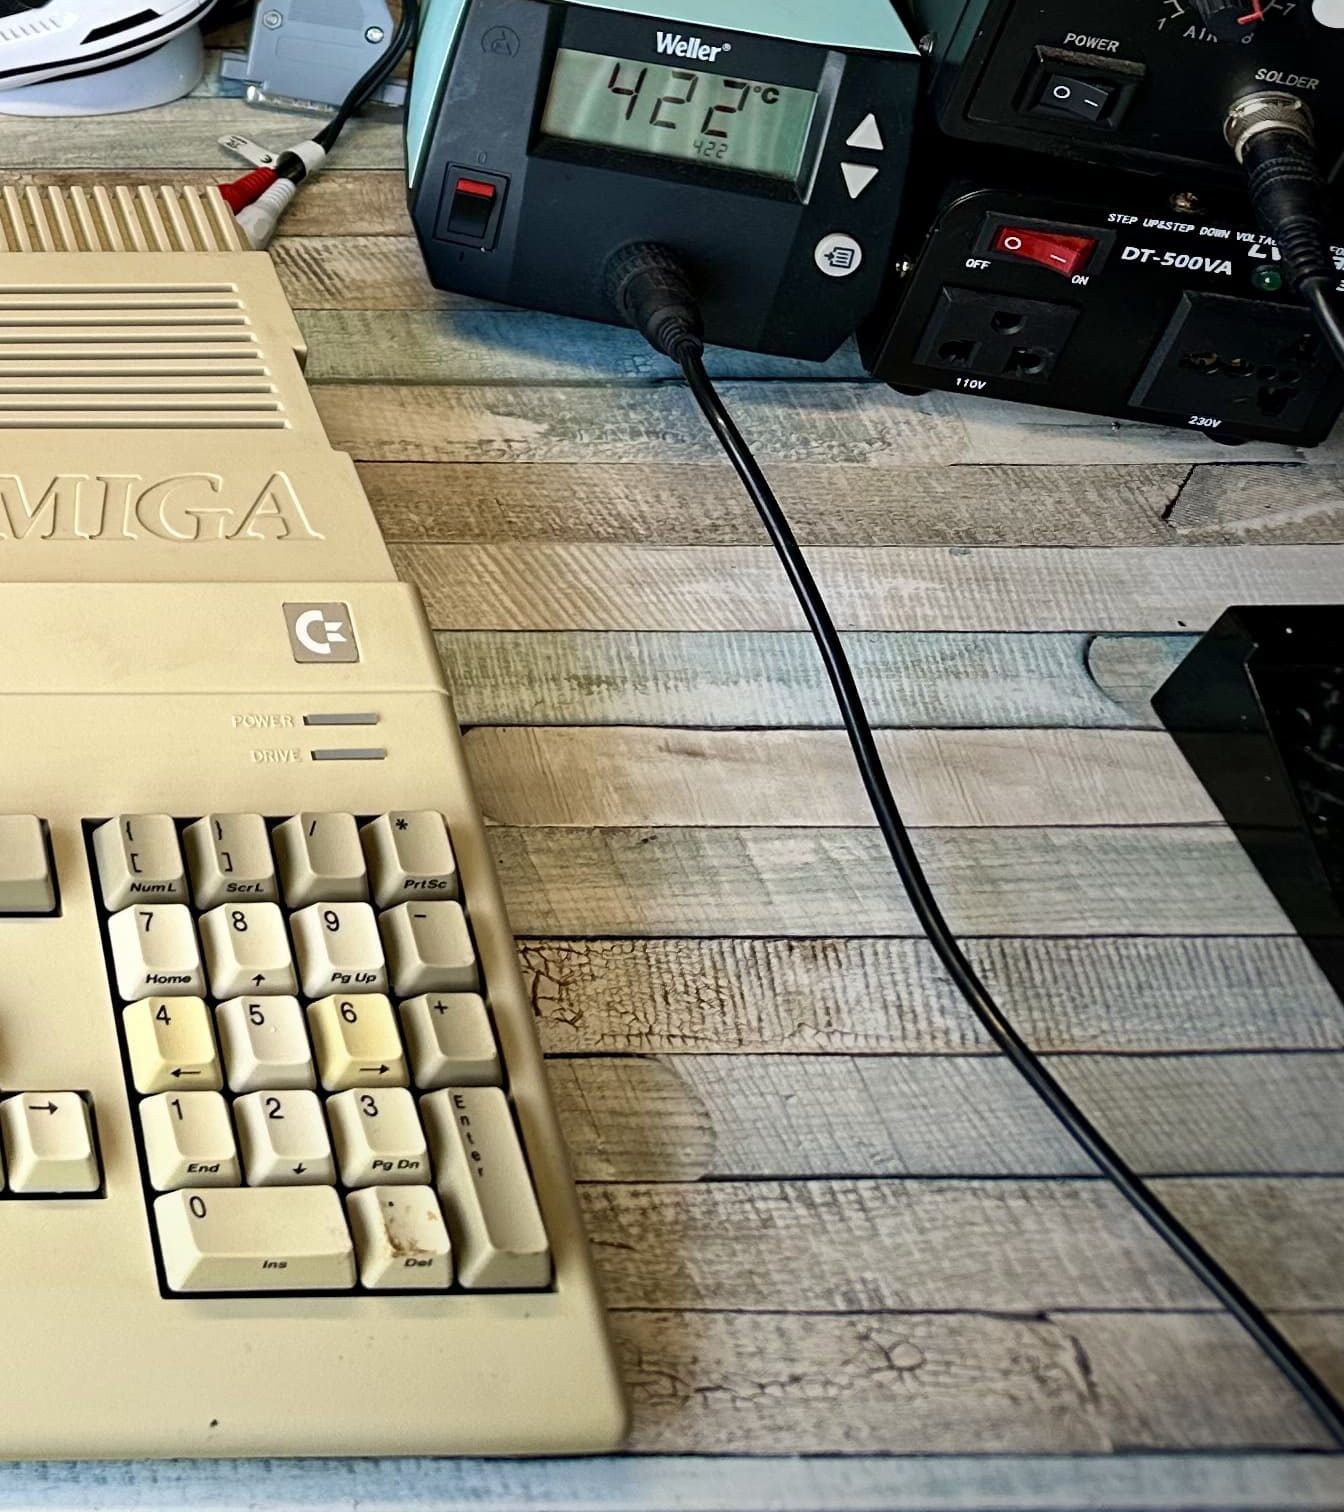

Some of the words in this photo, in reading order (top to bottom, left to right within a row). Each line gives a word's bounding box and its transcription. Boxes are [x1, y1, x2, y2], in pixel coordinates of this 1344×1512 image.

[1282, 3, 1295, 17] 7
[1156, 17, 1167, 31] 1
[1063, 31, 1121, 54] POWER
[1254, 68, 1320, 91] SOLDER
[607, 62, 749, 138] 422
[692, 139, 728, 160] 422
[1108, 213, 1139, 226] STEP
[1143, 218, 1196, 234] UP&STEP
[1199, 226, 1231, 239] DOWN
[965, 257, 991, 273] OFF
[1121, 246, 1233, 276] DT-500VA
[1071, 273, 1090, 288] ON
[955, 377, 987, 390] 110V
[1188, 415, 1223, 430] 230V
[231, 713, 294, 730] POWER
[250, 746, 302, 764] DRIVE
[404, 879, 448, 890] PrtSc
[145, 974, 192, 985] Home
[331, 973, 351, 986] Pg
[355, 973, 377, 986] Up
[453, 1094, 486, 1178] Enter
[187, 1163, 220, 1174] End
[372, 1159, 393, 1172] Pg
[397, 1159, 421, 1171] Dn
[262, 1259, 288, 1270] Ins
[404, 1257, 433, 1269] Del
